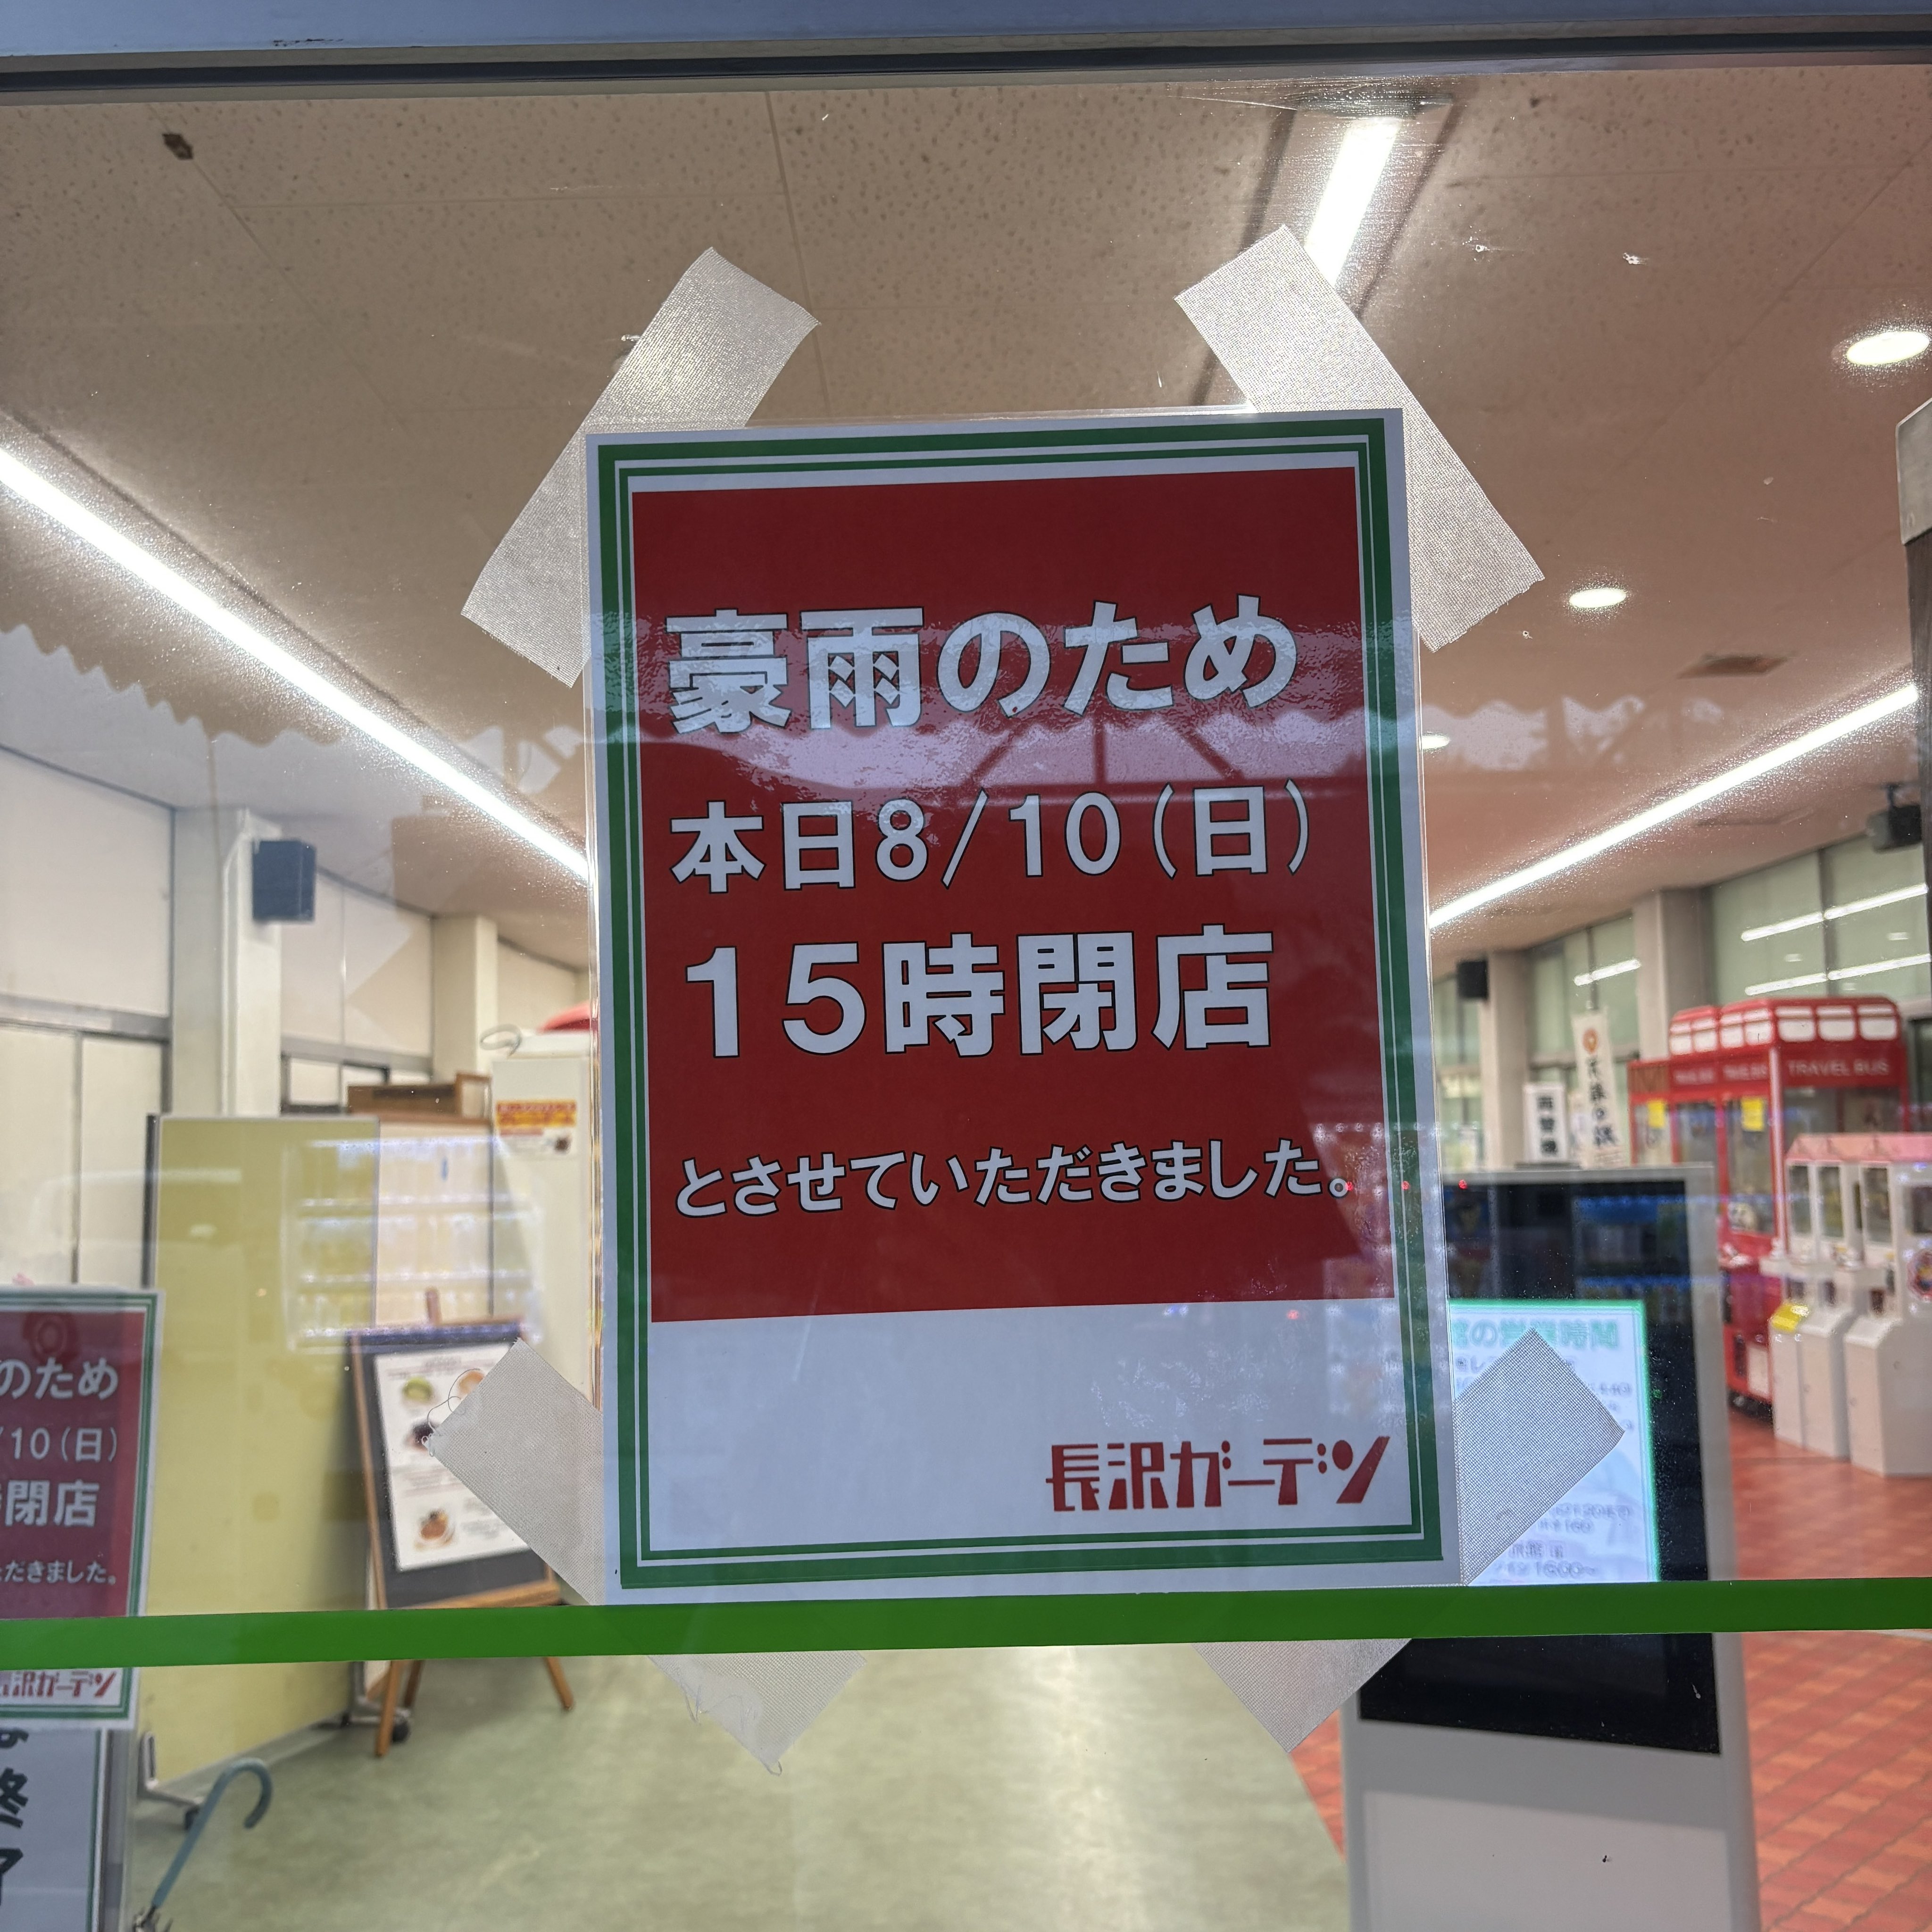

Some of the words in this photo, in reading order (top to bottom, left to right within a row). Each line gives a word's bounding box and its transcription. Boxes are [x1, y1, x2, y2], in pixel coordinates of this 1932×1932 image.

[666, 594, 1297, 734] 豪雨のため
[685, 923, 1274, 1058] 15時閉店
[1788, 1060, 1851, 1077] TRAVEL
[675, 1138, 1350, 1218] とさせていただきました。
[0, 1357, 118, 1400] のため
[0, 1479, 100, 1527] 閉店
[1046, 1436, 1391, 1512] 長沢ガーデン
[0, 1559, 117, 1585] だきました。
